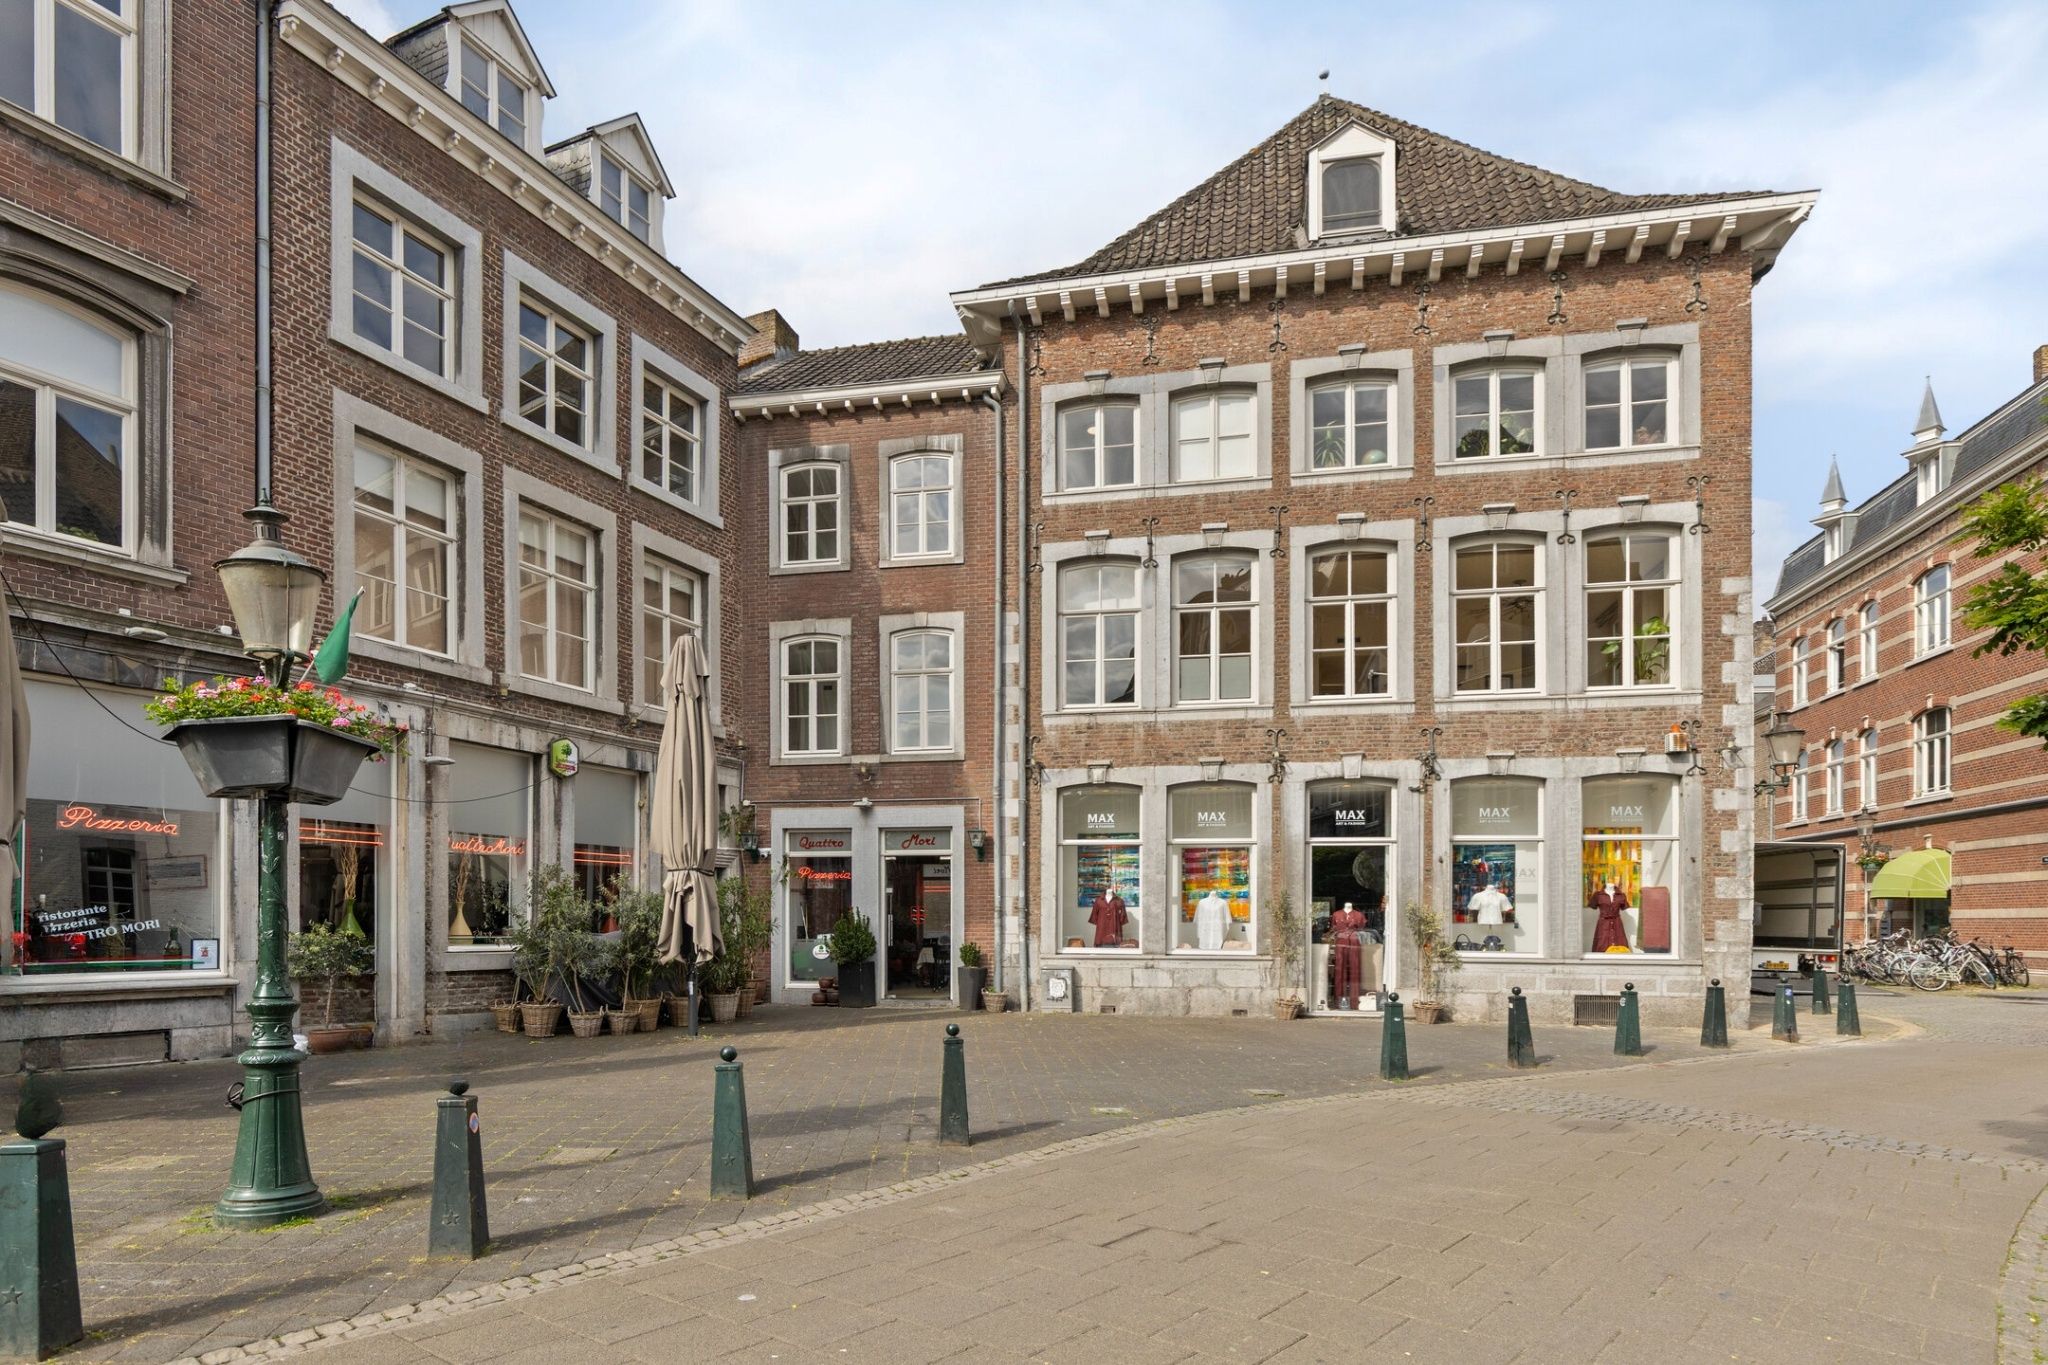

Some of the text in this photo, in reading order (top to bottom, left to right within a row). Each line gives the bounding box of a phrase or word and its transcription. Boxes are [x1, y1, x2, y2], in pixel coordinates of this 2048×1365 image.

[1197, 811, 1226, 822] MAX
[1335, 809, 1366, 820] MAX
[1479, 807, 1511, 818] MAX
[1610, 805, 1643, 816] MAX
[60, 806, 178, 835] Pizzeria
[1087, 813, 1115, 823] MAX
[448, 836, 493, 852] uattro
[799, 833, 936, 850] Quattro Mori
[798, 866, 852, 880] Pizzeria
[38, 905, 107, 922] ristorante
[121, 919, 160, 935] MORI
